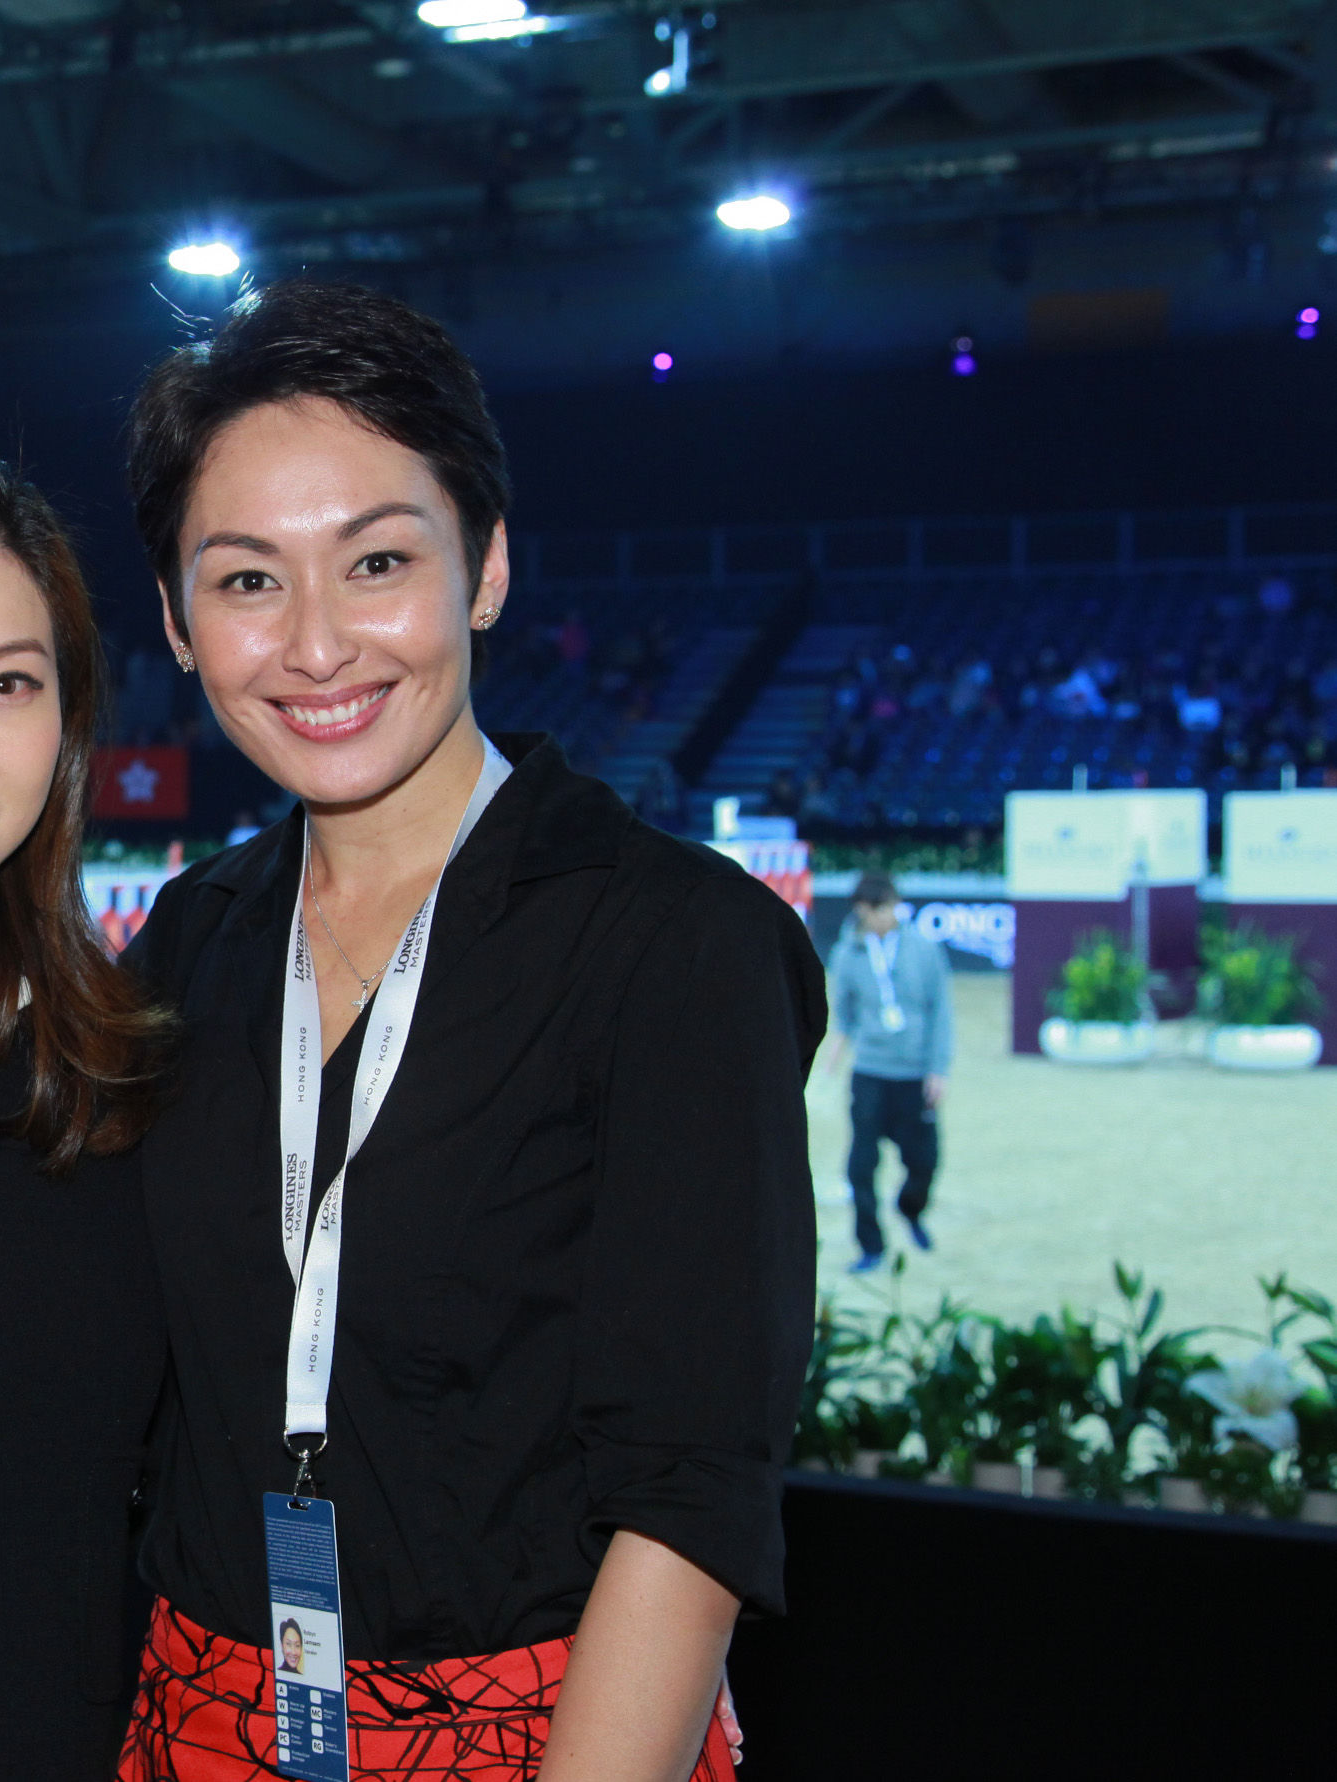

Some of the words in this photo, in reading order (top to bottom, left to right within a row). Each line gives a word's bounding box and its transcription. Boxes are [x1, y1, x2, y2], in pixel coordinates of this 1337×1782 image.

[393, 896, 429, 974] LONGIN
[409, 899, 432, 968] MASTERS
[299, 1026, 307, 1060] KONG
[363, 1067, 382, 1106] HONG
[378, 1025, 393, 1062] KONG
[297, 1065, 306, 1103] HONG
[284, 1152, 298, 1241] LONGINES
[295, 1160, 308, 1231] MASTERS
[308, 1333, 319, 1373] HONG
[314, 1287, 324, 1327] KONG
